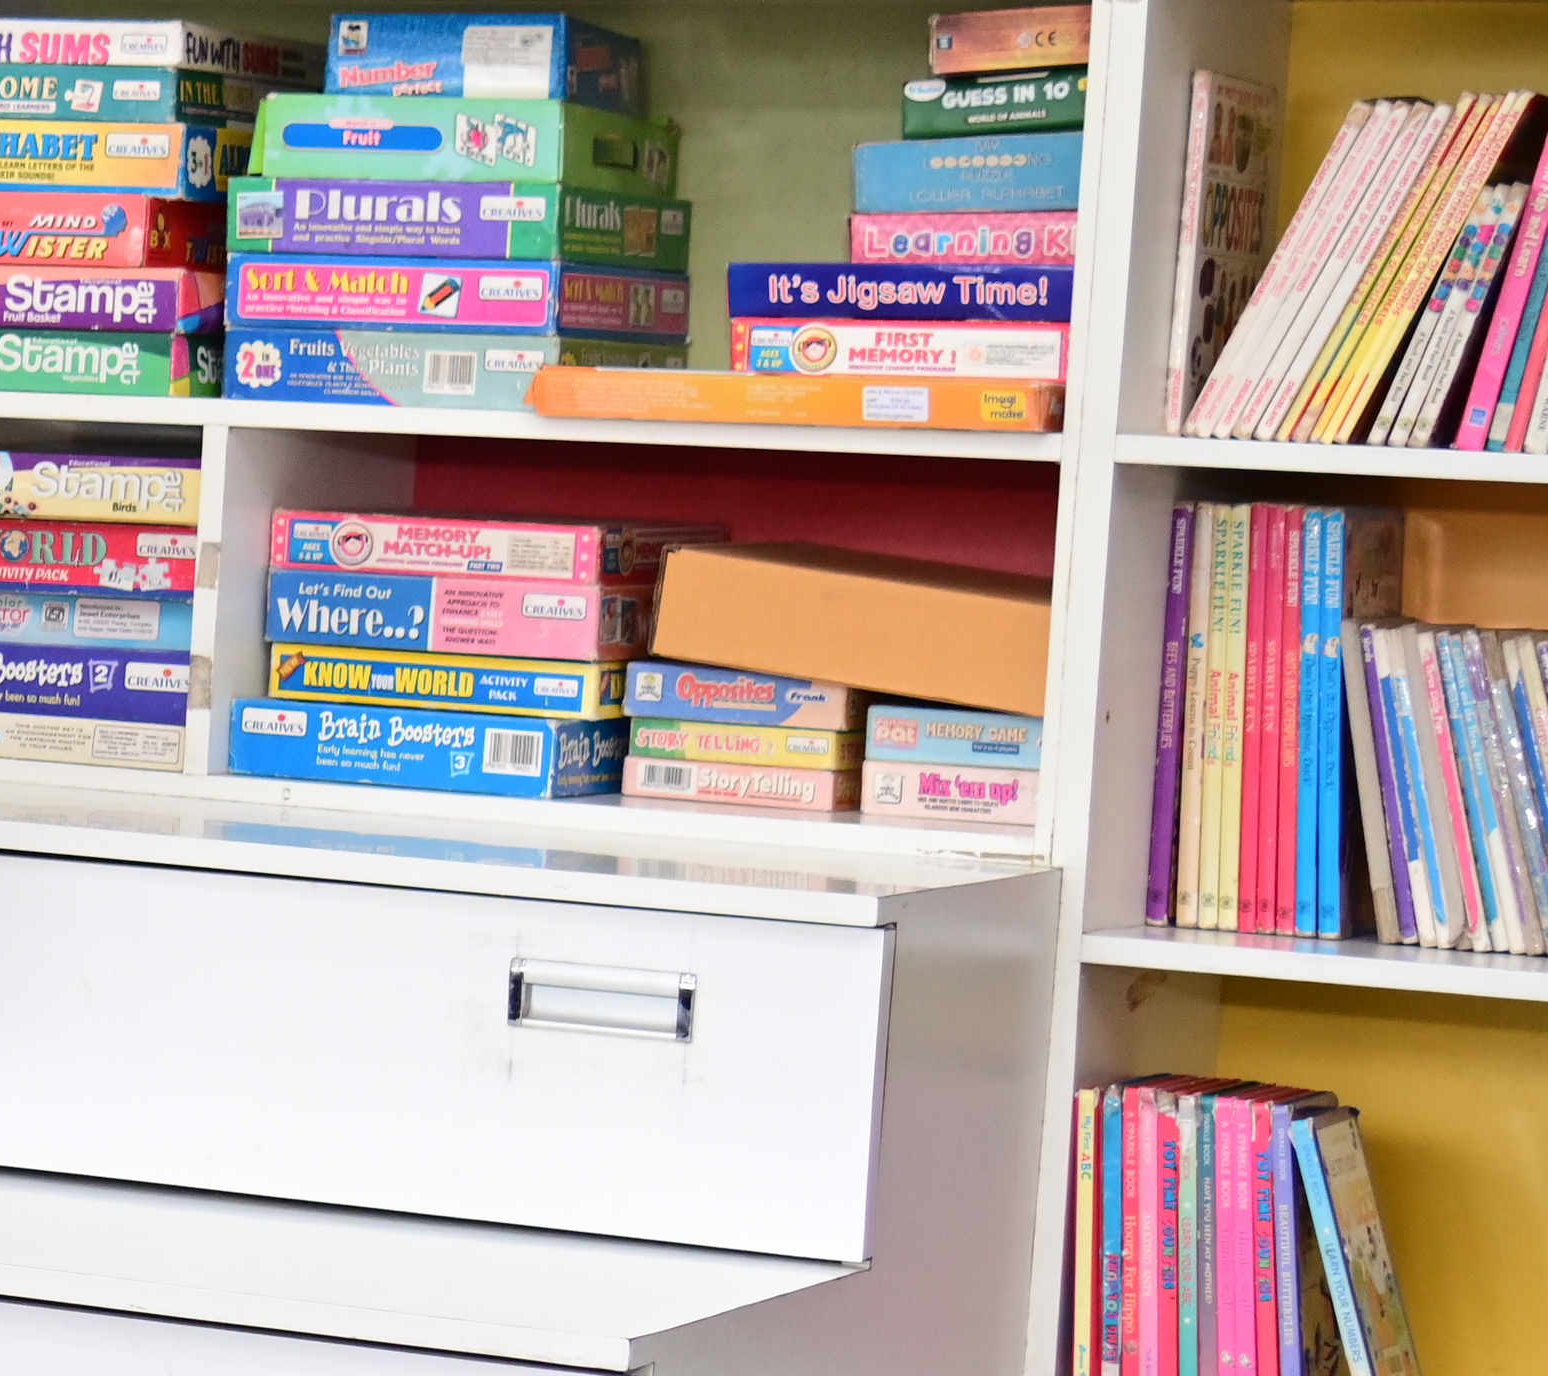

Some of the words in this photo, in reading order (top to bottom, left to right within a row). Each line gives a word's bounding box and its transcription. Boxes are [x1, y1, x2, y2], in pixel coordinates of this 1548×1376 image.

[19, 32, 111, 65] SUMS
[338, 61, 437, 88] Number
[941, 85, 1007, 109] GUESS
[1013, 84, 1036, 103] IN
[1042, 80, 1071, 101] 10
[342, 129, 382, 147] Fruit
[295, 189, 462, 223] Plurals
[29, 214, 97, 228] MIND
[245, 268, 296, 293] Sort
[306, 269, 321, 293] &
[327, 270, 410, 294] Match
[5, 274, 139, 323] Stamp
[768, 274, 821, 305] It's
[827, 274, 947, 310] Jigsaw
[953, 276, 1049, 306] Time!
[3, 310, 26, 322] Fruit
[27, 312, 61, 324] Basket
[288, 338, 336, 357] Fruits
[339, 342, 421, 360] Vegetables
[874, 331, 934, 347] FIRST
[848, 347, 944, 364] MEMORY
[368, 359, 420, 376] Plants
[30, 461, 166, 511] Stamp
[112, 501, 137, 513] Birds
[397, 526, 480, 543] MEMORY
[383, 541, 491, 560] MATCH-UP!
[1232, 520, 1245, 592] SPARKLE
[35, 568, 69, 582] PACK
[298, 582, 329, 597] Let's
[333, 584, 363, 598] Find
[366, 585, 392, 600] Out
[277, 597, 425, 641] Where..?
[1230, 598, 1242, 635] FUN!
[94, 664, 109, 683] 2
[303, 661, 372, 691] KNOW
[371, 674, 394, 691] YOUR
[394, 667, 474, 698] WORLD
[479, 675, 528, 689] ACTIVITY
[488, 689, 518, 701] PACK
[676, 673, 776, 708] Opposites
[790, 691, 826, 703] Frank
[243, 719, 304, 735] CREATIVES
[318, 711, 381, 744] Brain
[388, 716, 475, 748] Boosters
[926, 722, 985, 741] MEMORY
[988, 727, 1028, 743] GAME
[635, 728, 689, 751] STORY
[696, 733, 761, 754] TELLING
[454, 755, 466, 770] 3
[918, 772, 952, 797] Mix
[954, 775, 988, 799] 'em
[989, 779, 1019, 806] up!
[1325, 1242, 1342, 1277] LEARN
[1334, 1277, 1351, 1309] YOUR
[1343, 1310, 1363, 1364] NUMBERS
